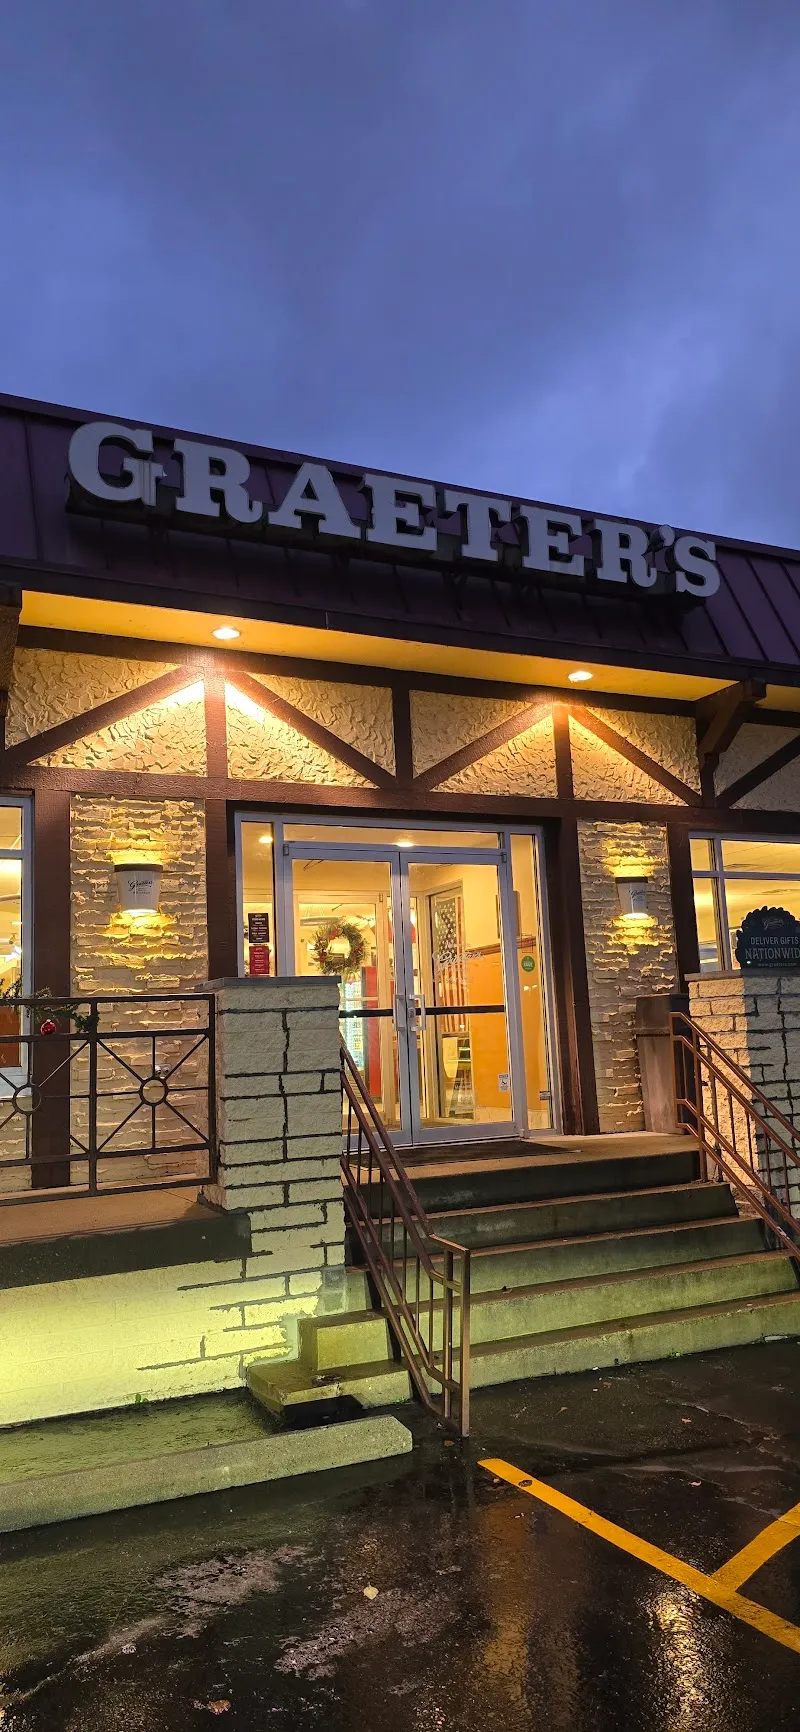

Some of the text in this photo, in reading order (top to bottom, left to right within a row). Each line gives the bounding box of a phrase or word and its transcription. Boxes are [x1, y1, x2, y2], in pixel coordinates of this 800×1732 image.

[68, 421, 721, 598] GRAETER'S
[750, 936, 799, 945] DELIVER GIFTS
